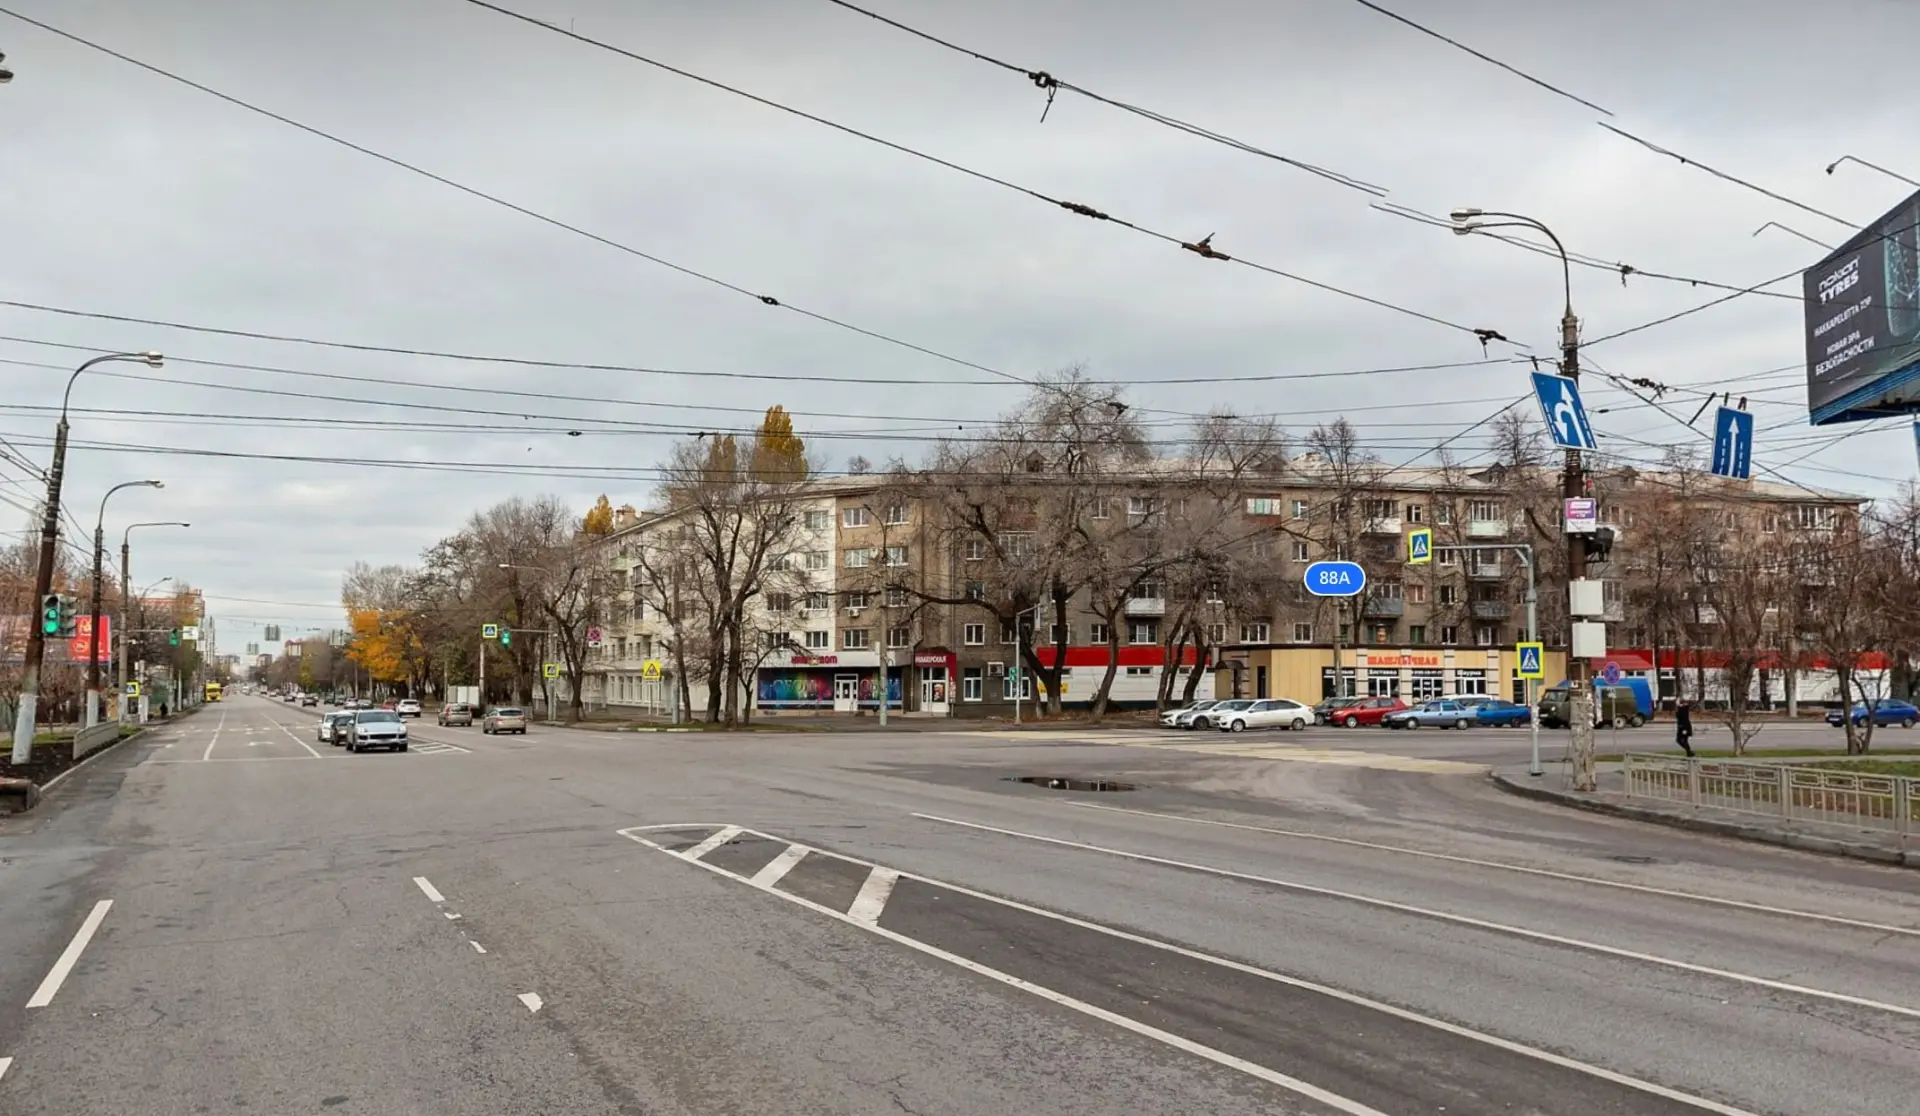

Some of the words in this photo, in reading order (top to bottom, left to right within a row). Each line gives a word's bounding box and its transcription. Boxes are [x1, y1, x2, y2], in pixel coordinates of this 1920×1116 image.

[1820, 270, 1859, 304] TYRES
[1815, 336, 1875, 376] БЕЗОПАСНОСТИ
[1827, 337, 1848, 356] НОВАЯ
[1367, 654, 1438, 665] ШАШЛЫЧНАЯ
